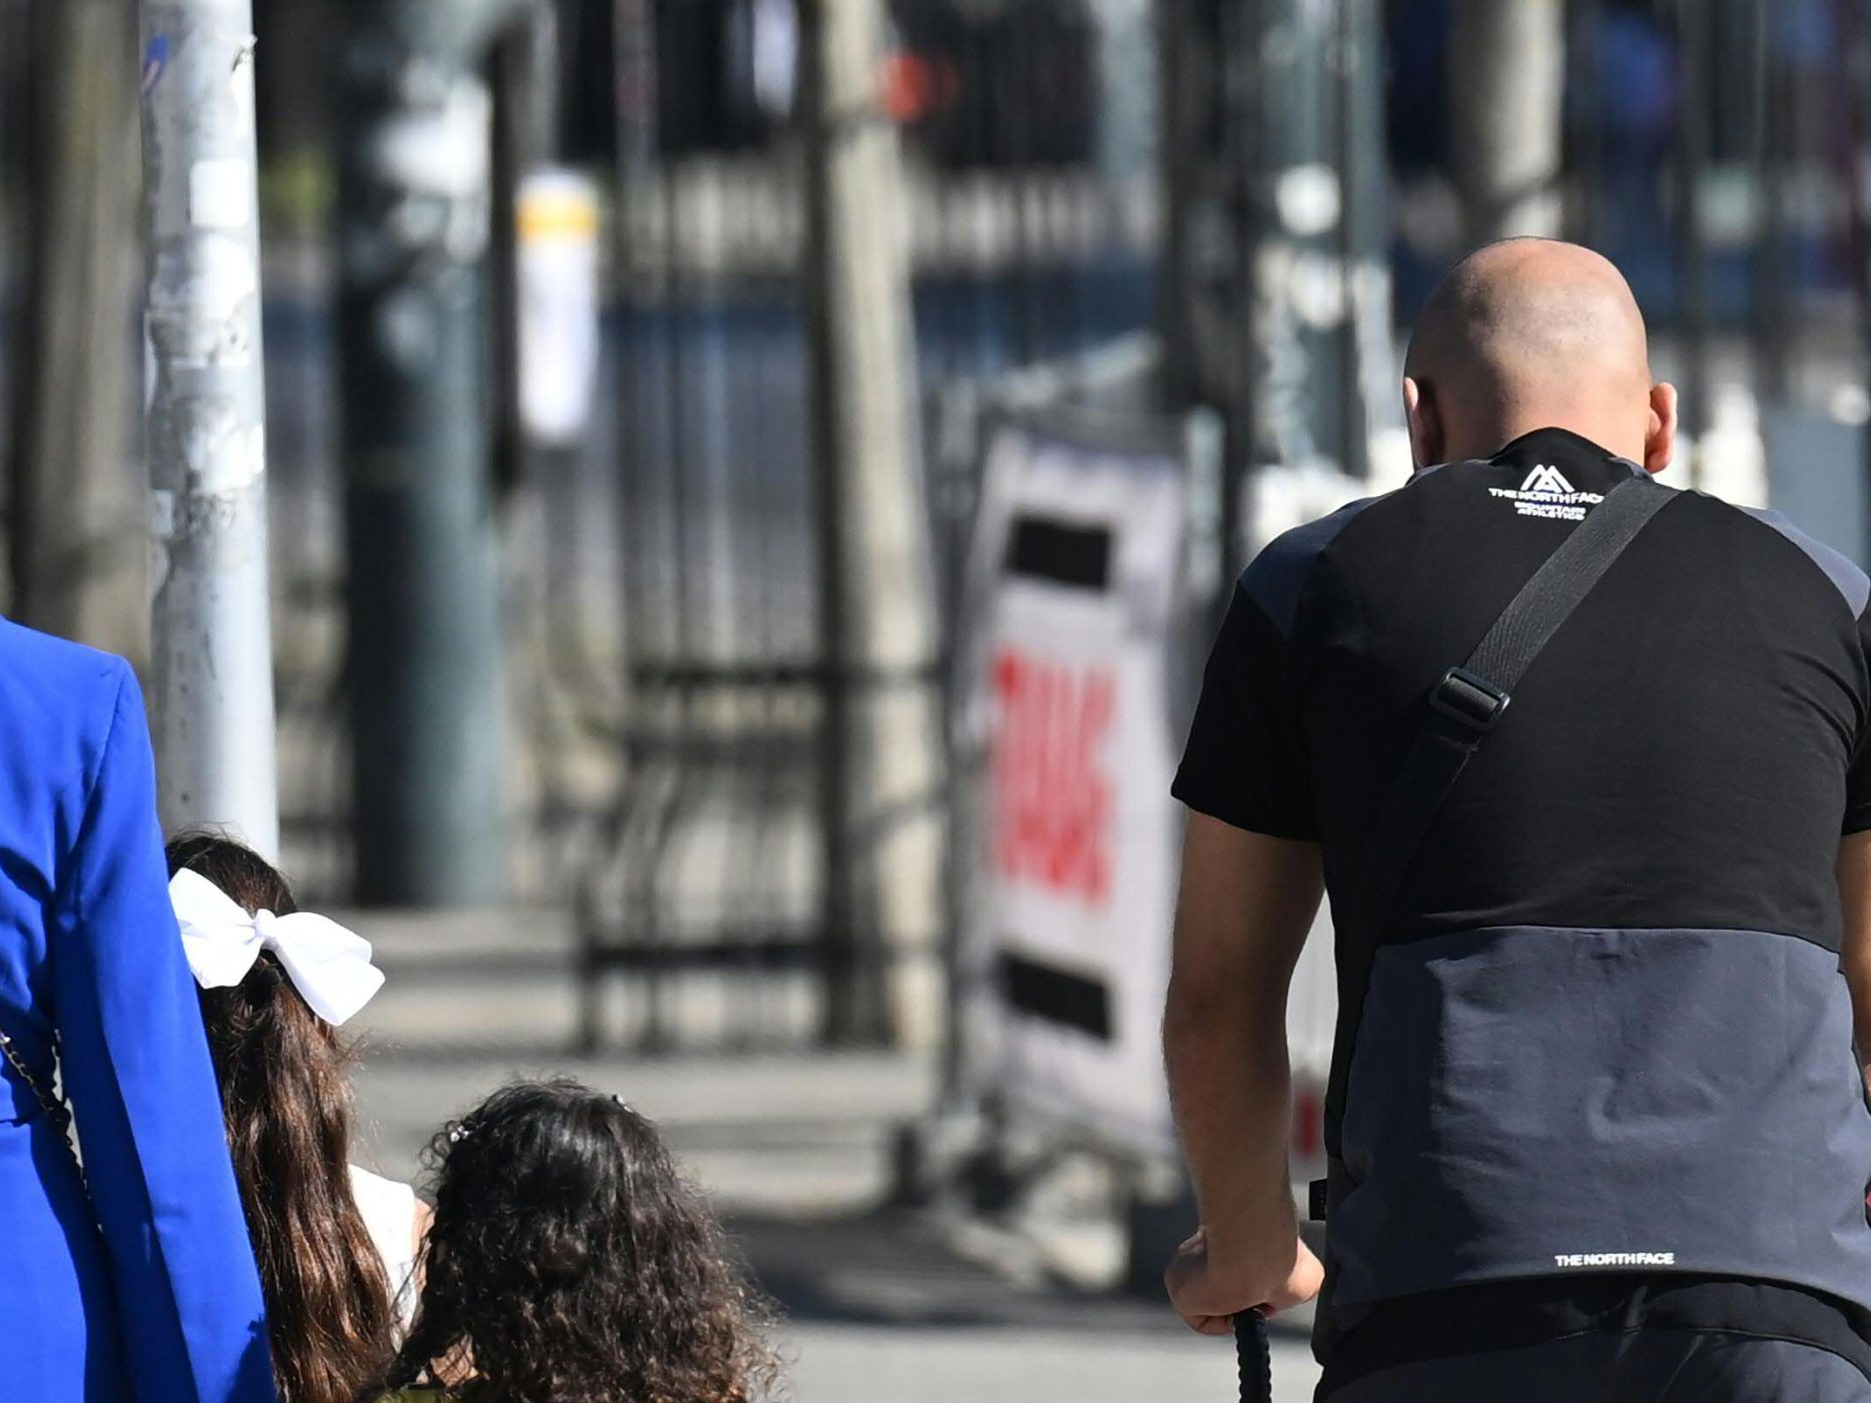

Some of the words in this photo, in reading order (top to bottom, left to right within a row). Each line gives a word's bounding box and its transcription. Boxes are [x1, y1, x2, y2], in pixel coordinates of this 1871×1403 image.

[1488, 488, 1517, 499] THE
[1518, 490, 1570, 504] NORTH
[1554, 1255, 1583, 1267] THE
[1584, 1253, 1636, 1265] NORTH
[1636, 1252, 1675, 1265] FACE
